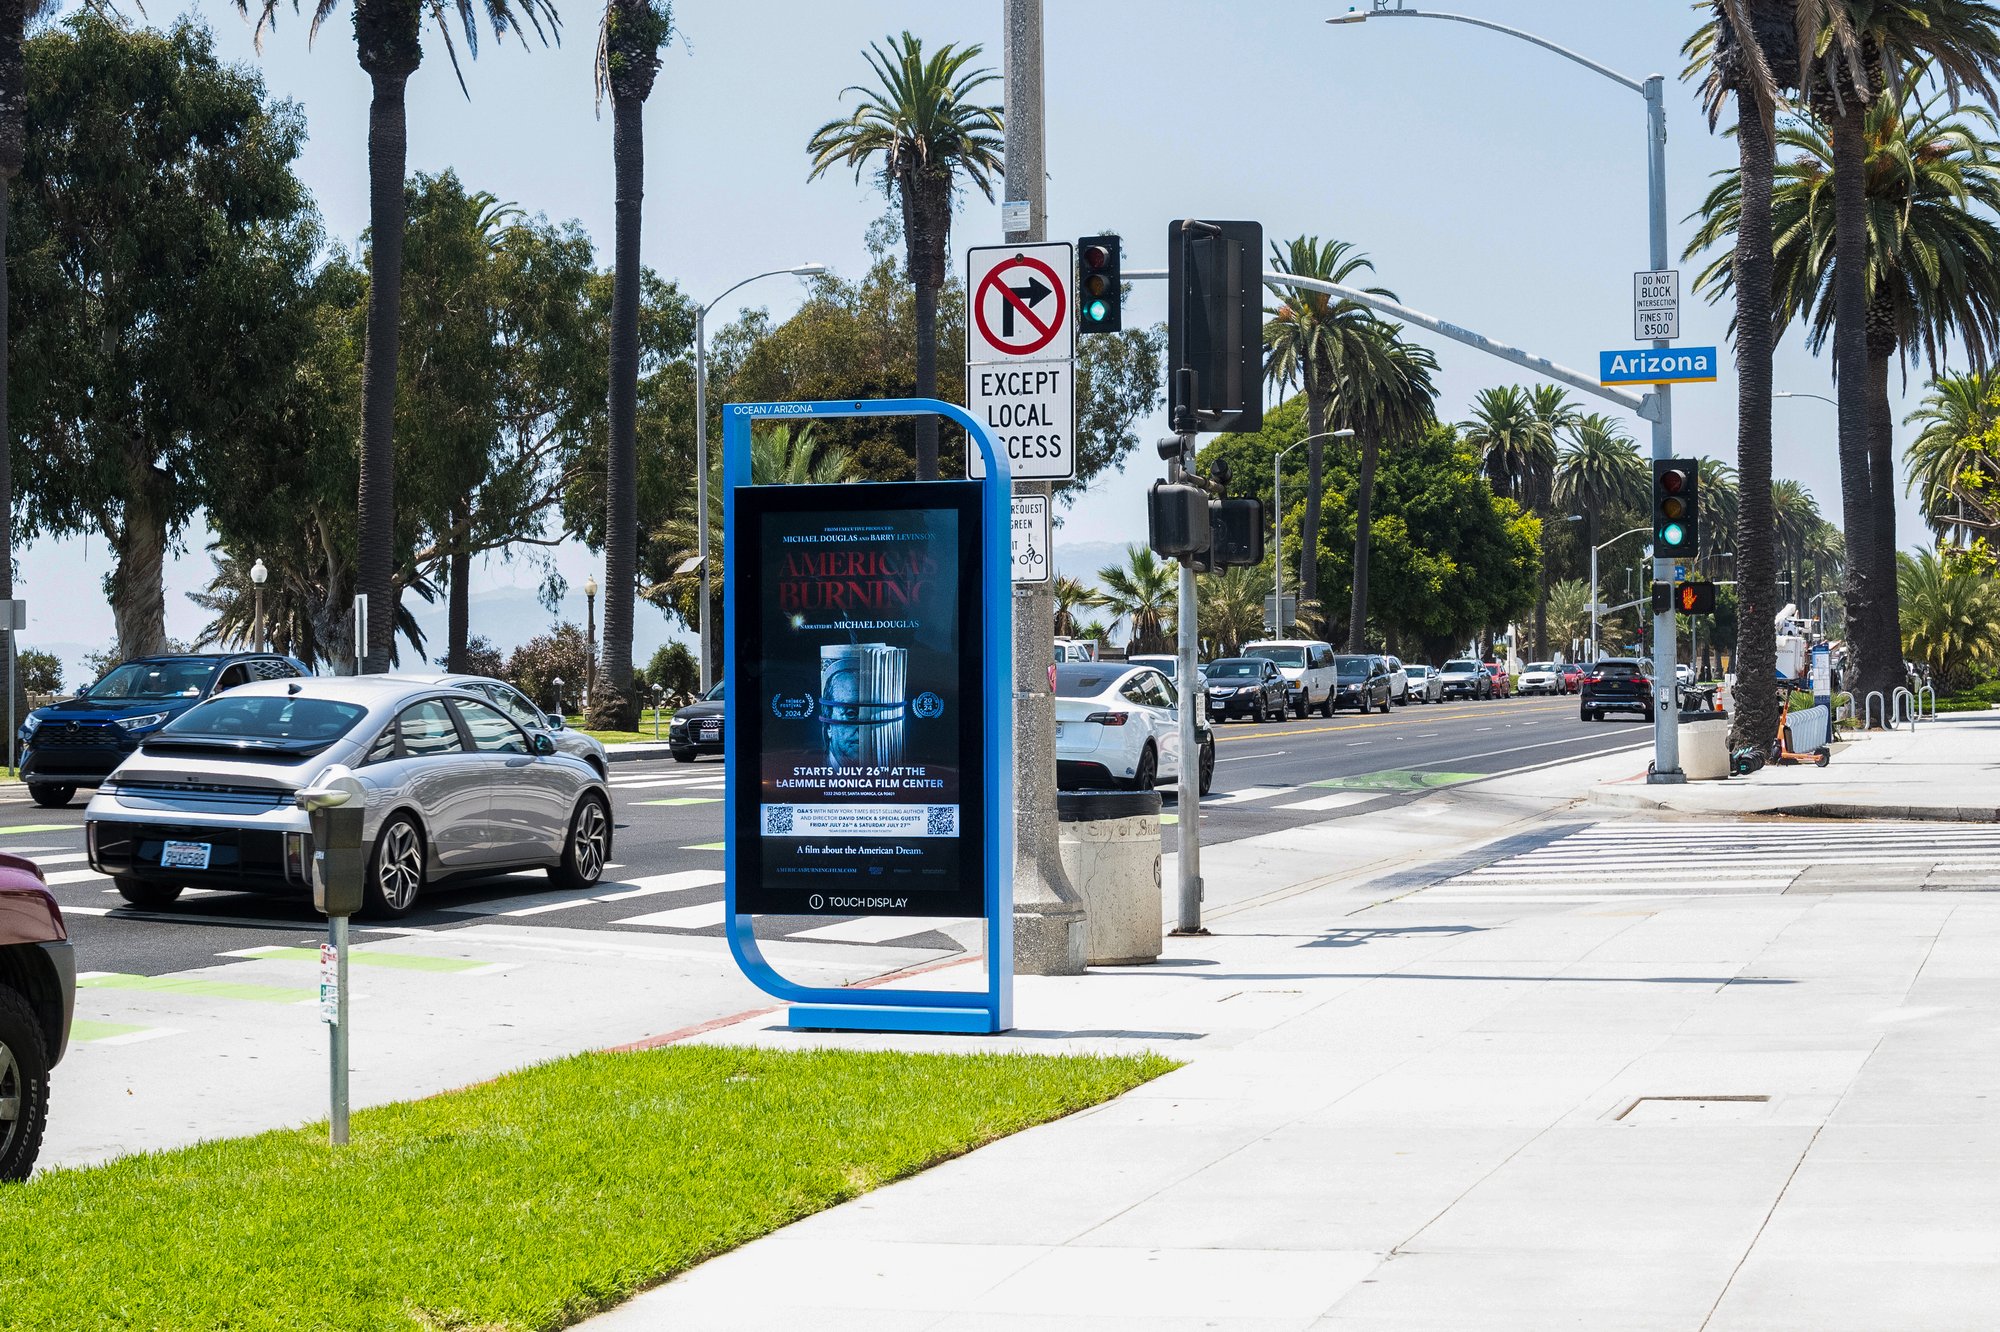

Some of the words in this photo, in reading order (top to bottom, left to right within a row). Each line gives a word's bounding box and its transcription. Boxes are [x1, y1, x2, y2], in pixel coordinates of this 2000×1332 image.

[1642, 276, 1653, 285] DO
[1655, 275, 1670, 284] NOT
[1641, 286, 1671, 298] BLOCK
[1636, 299, 1676, 307] INTERSECTION
[1640, 313, 1661, 322] FINES
[1664, 312, 1673, 321] TO
[1644, 323, 1669, 335] $500
[1610, 352, 1707, 374] Arizona
[981, 371, 1060, 396] EXCEPT
[733, 406, 767, 415] OCEAN
[767, 406, 773, 414] /
[773, 404, 814, 413] ARIZONA
[988, 403, 1053, 428] LOCAL
[1011, 504, 1042, 514] REQUEST
[783, 535, 819, 543] MICHAEL
[820, 534, 858, 542] DOUGLAS
[897, 532, 936, 541] LEVINSON
[833, 621, 875, 629] MICHAEL
[876, 620, 919, 629] DOUGLAS
[793, 766, 833, 776] STARTS
[836, 766, 863, 776] JULY
[866, 766, 889, 776] 26TH
[890, 766, 904, 776] AT
[905, 766, 926, 776] THE
[776, 779, 826, 788] LAEMMLE
[828, 779, 873, 788] MONICA
[875, 779, 900, 788] FILM
[902, 779, 944, 788] CENTER
[796, 846, 804, 854] A
[804, 845, 821, 854] film
[821, 845, 843, 854] about
[844, 845, 857, 854] the
[857, 846, 894, 855] American
[895, 846, 924, 855] Dream.
[828, 897, 866, 907] TOUCH
[867, 897, 909, 908] DISPLAY
